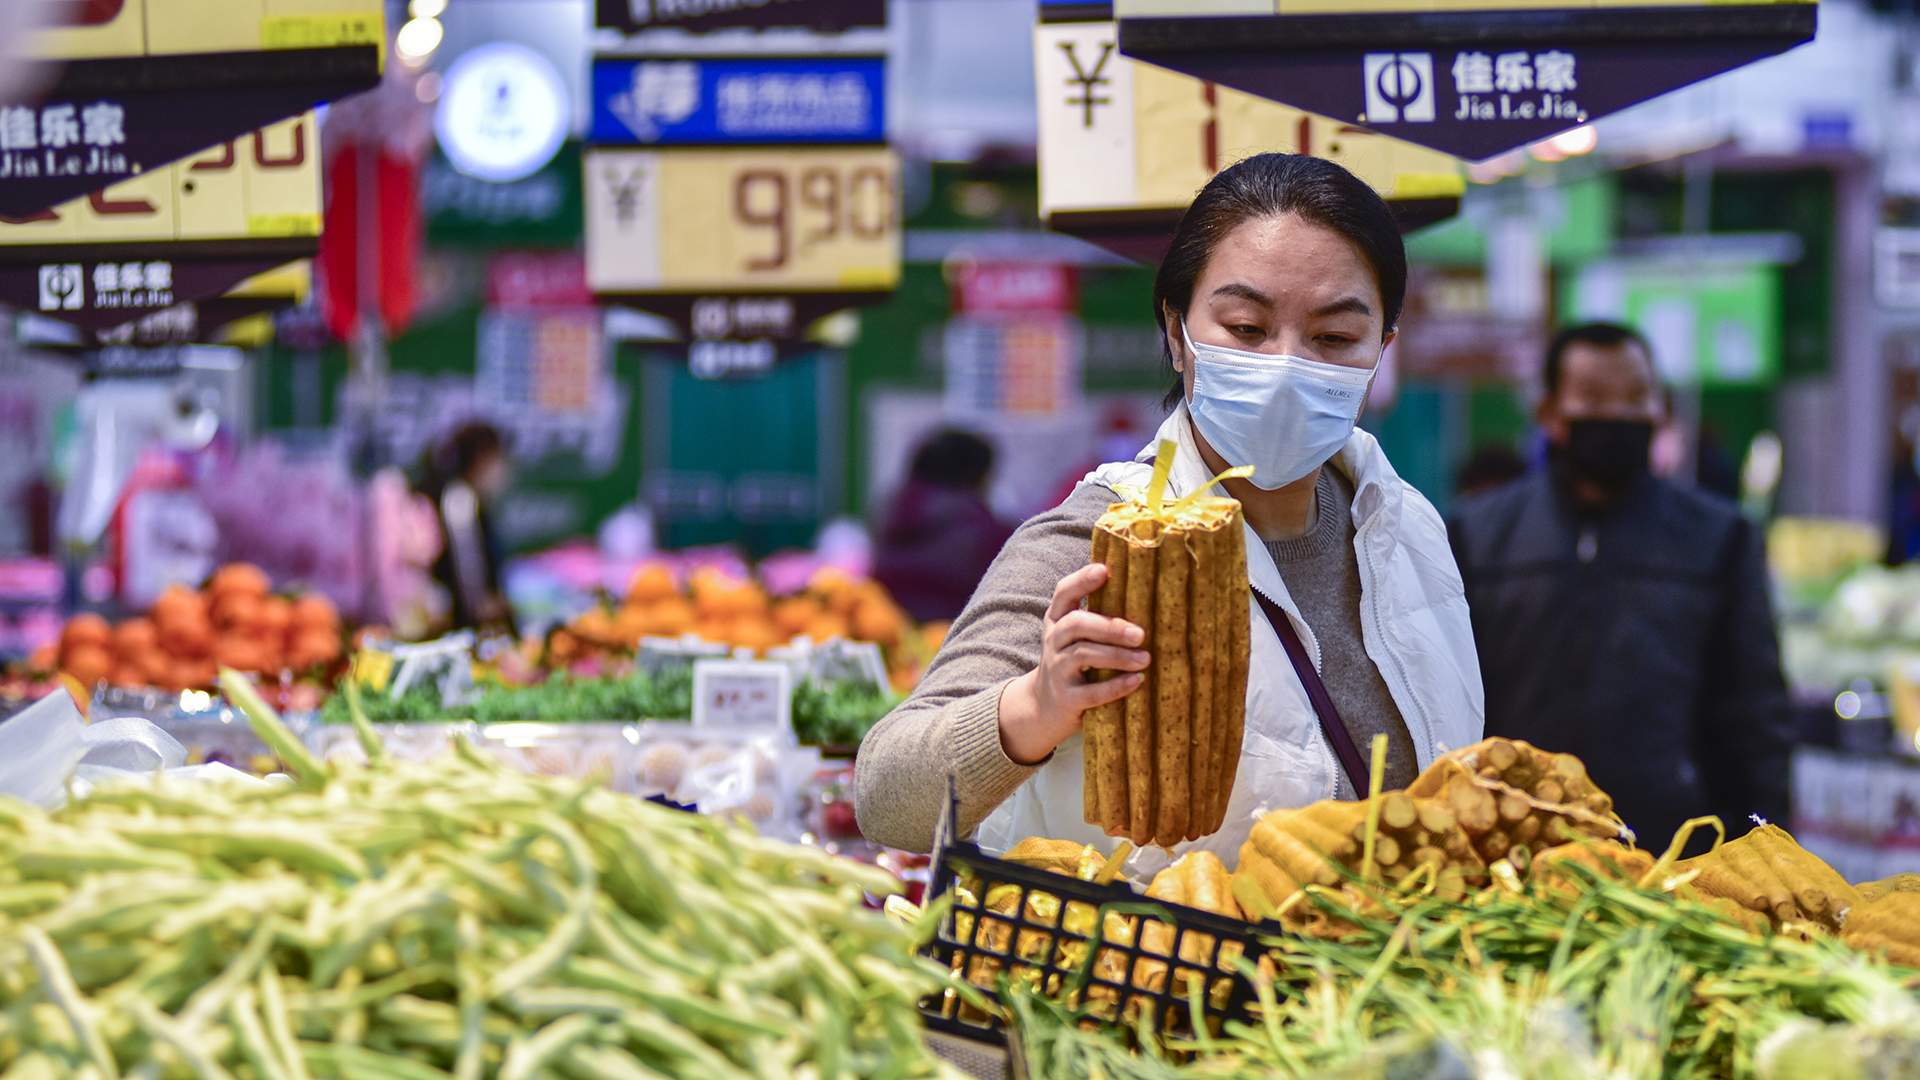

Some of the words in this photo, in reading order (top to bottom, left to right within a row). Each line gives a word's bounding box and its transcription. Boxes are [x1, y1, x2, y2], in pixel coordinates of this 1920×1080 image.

[1452, 50, 1577, 92] 佳乐家
[1455, 95, 1496, 119] Jia
[1501, 94, 1536, 119] Le
[0, 102, 125, 149] 佳乐家
[46, 150, 80, 175] Le
